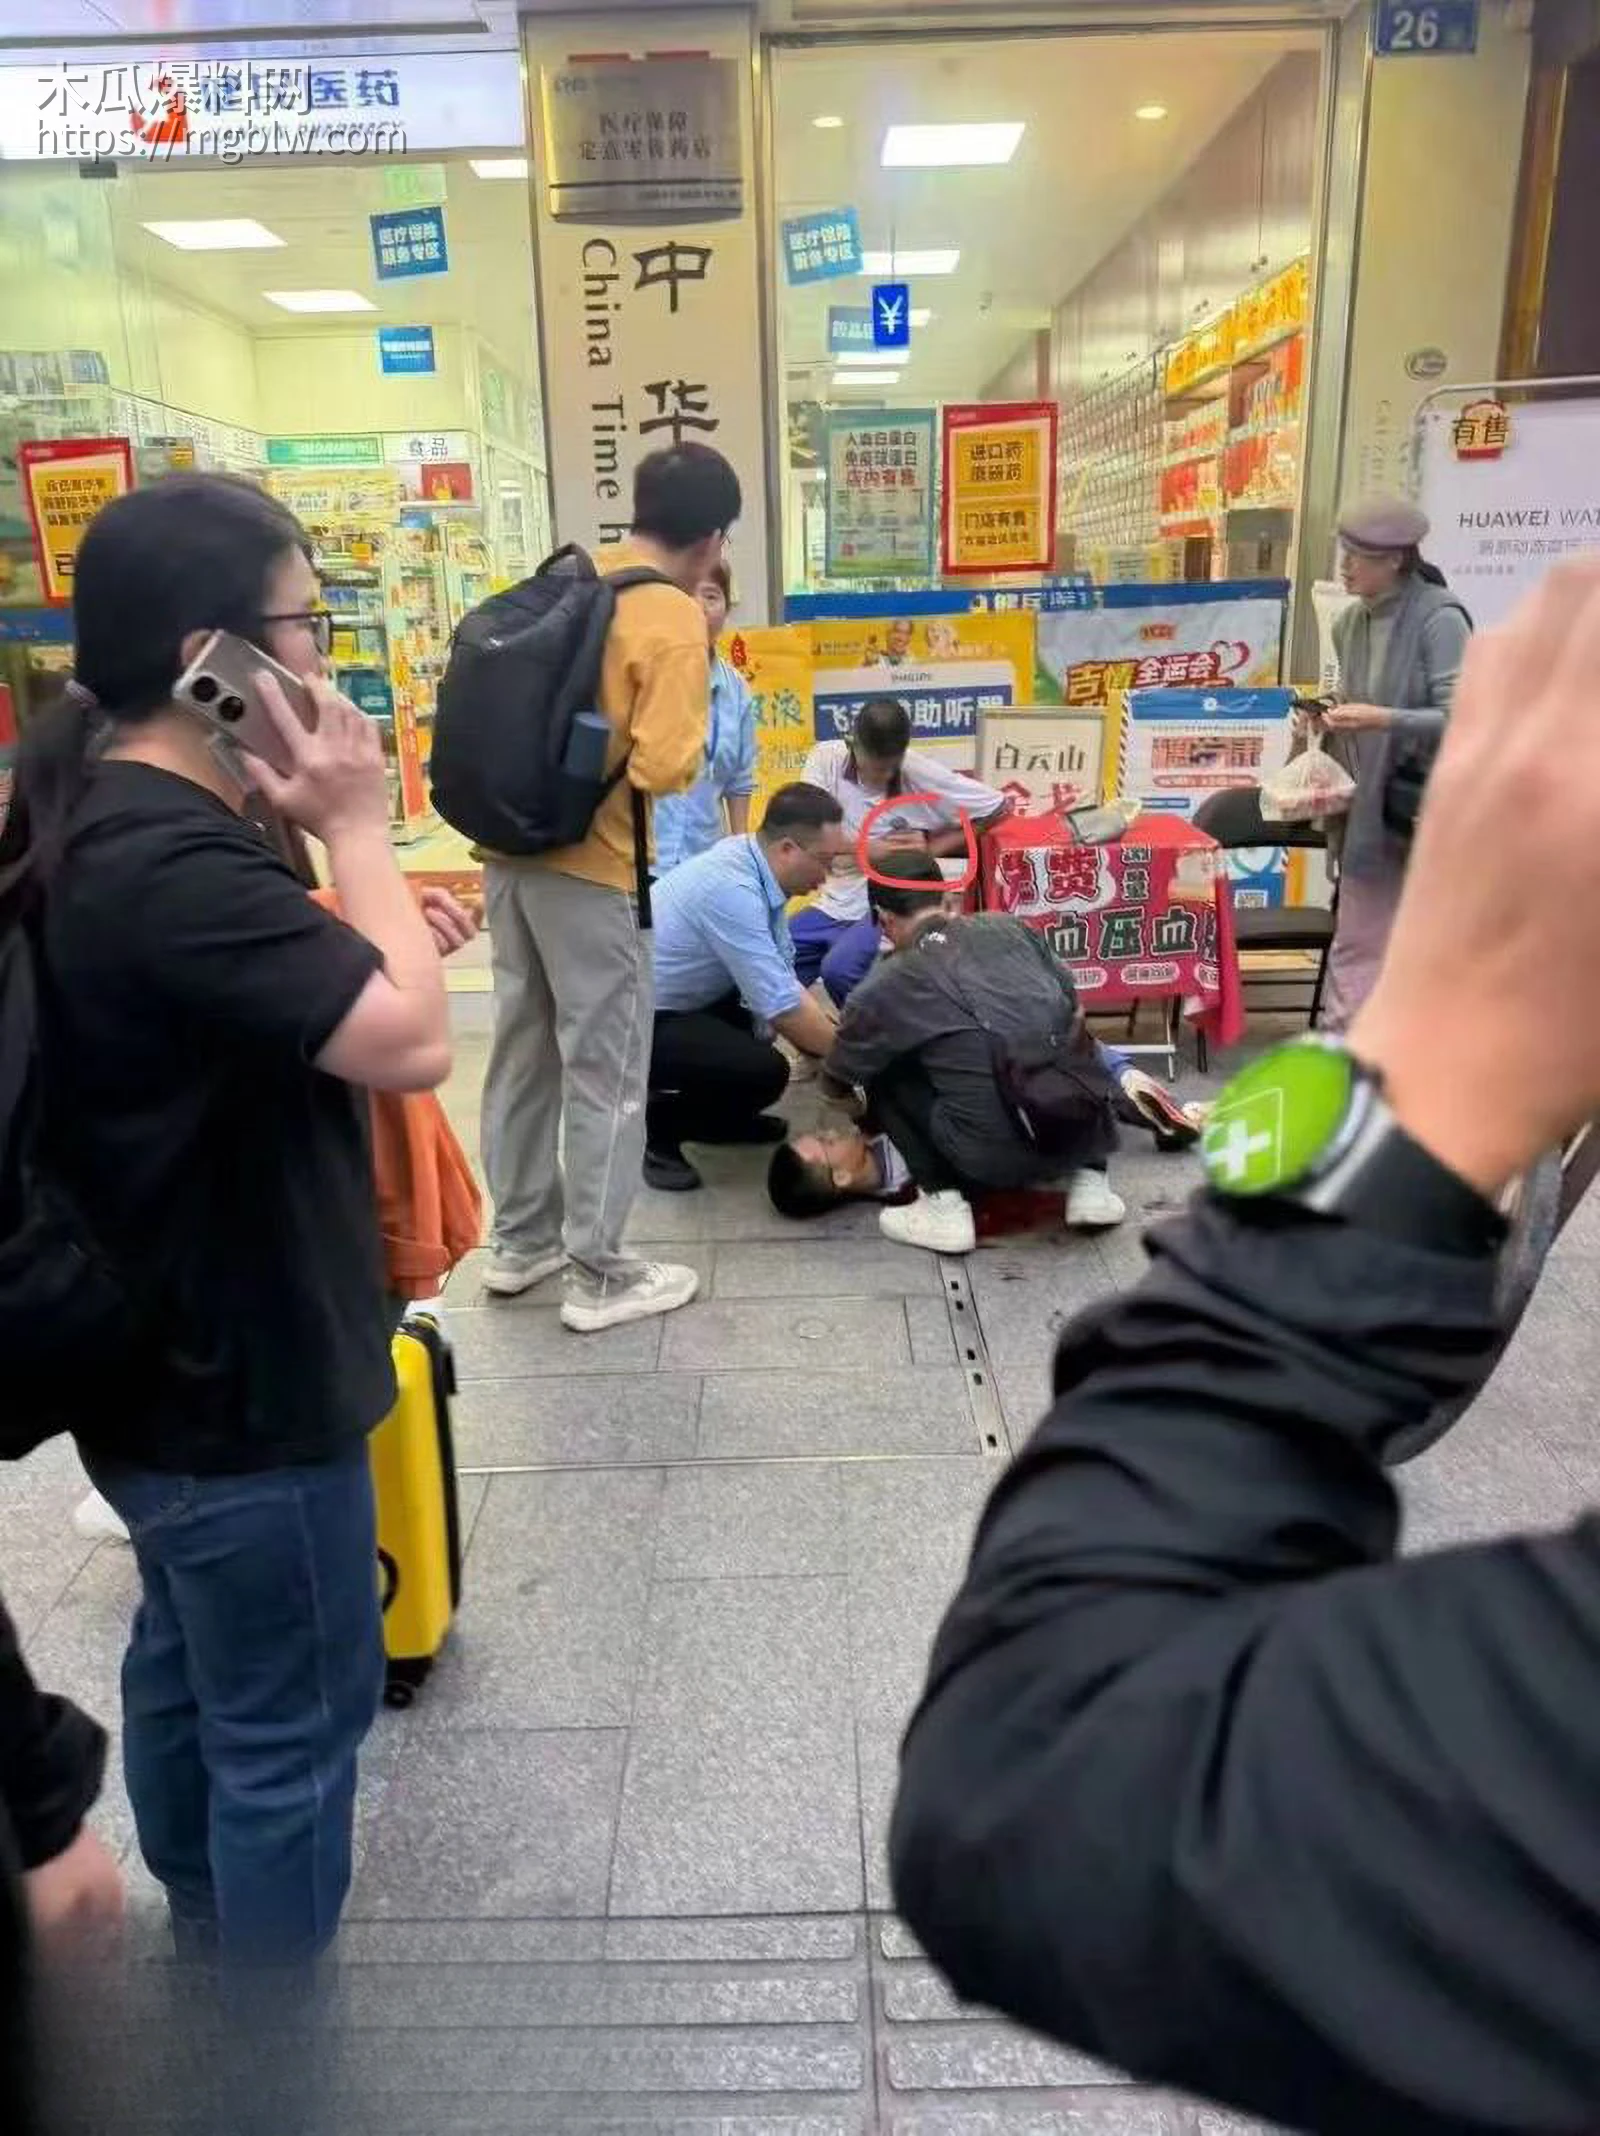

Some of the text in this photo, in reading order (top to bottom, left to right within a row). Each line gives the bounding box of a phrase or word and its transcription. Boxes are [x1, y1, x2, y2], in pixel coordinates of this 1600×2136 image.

[1391, 8, 1438, 48] 26
[582, 238, 621, 368] China
[591, 395, 627, 500] Time
[1459, 510, 1548, 528] HUAWEI
[996, 743, 1084, 772] 白云山
